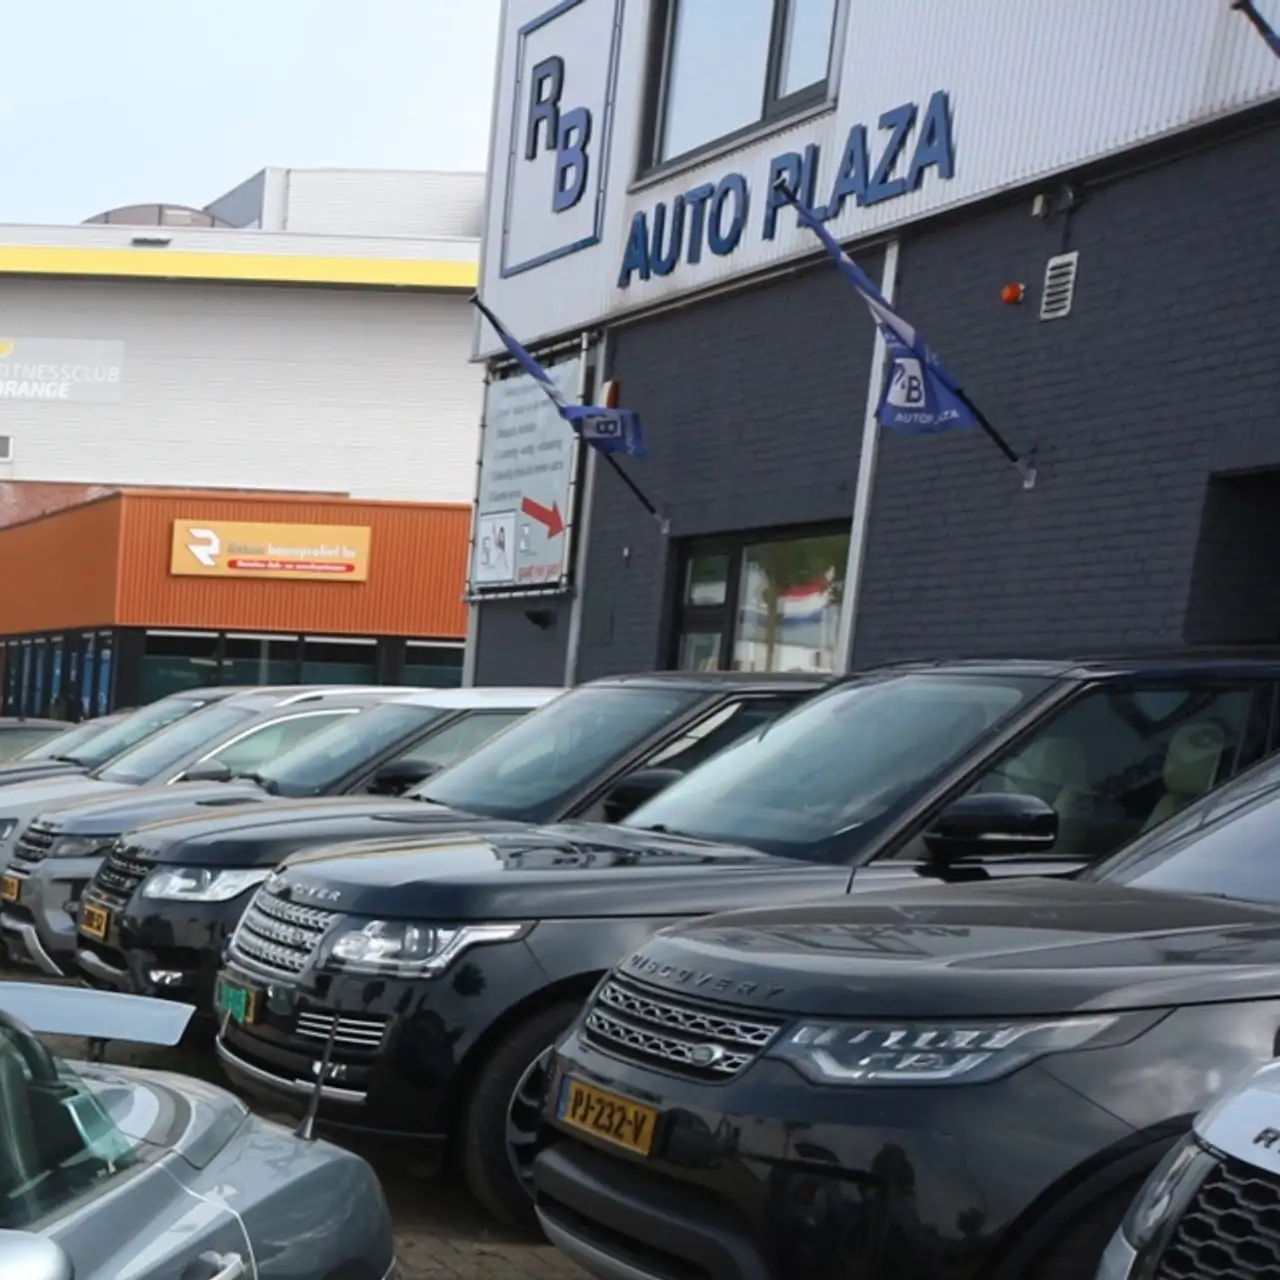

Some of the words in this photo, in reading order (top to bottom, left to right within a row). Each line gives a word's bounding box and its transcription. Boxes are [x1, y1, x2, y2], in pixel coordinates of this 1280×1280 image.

[618, 173, 748, 289] AUTO
[762, 90, 955, 241] PLAZA
[571, 1087, 647, 1145] PJ-232-V
